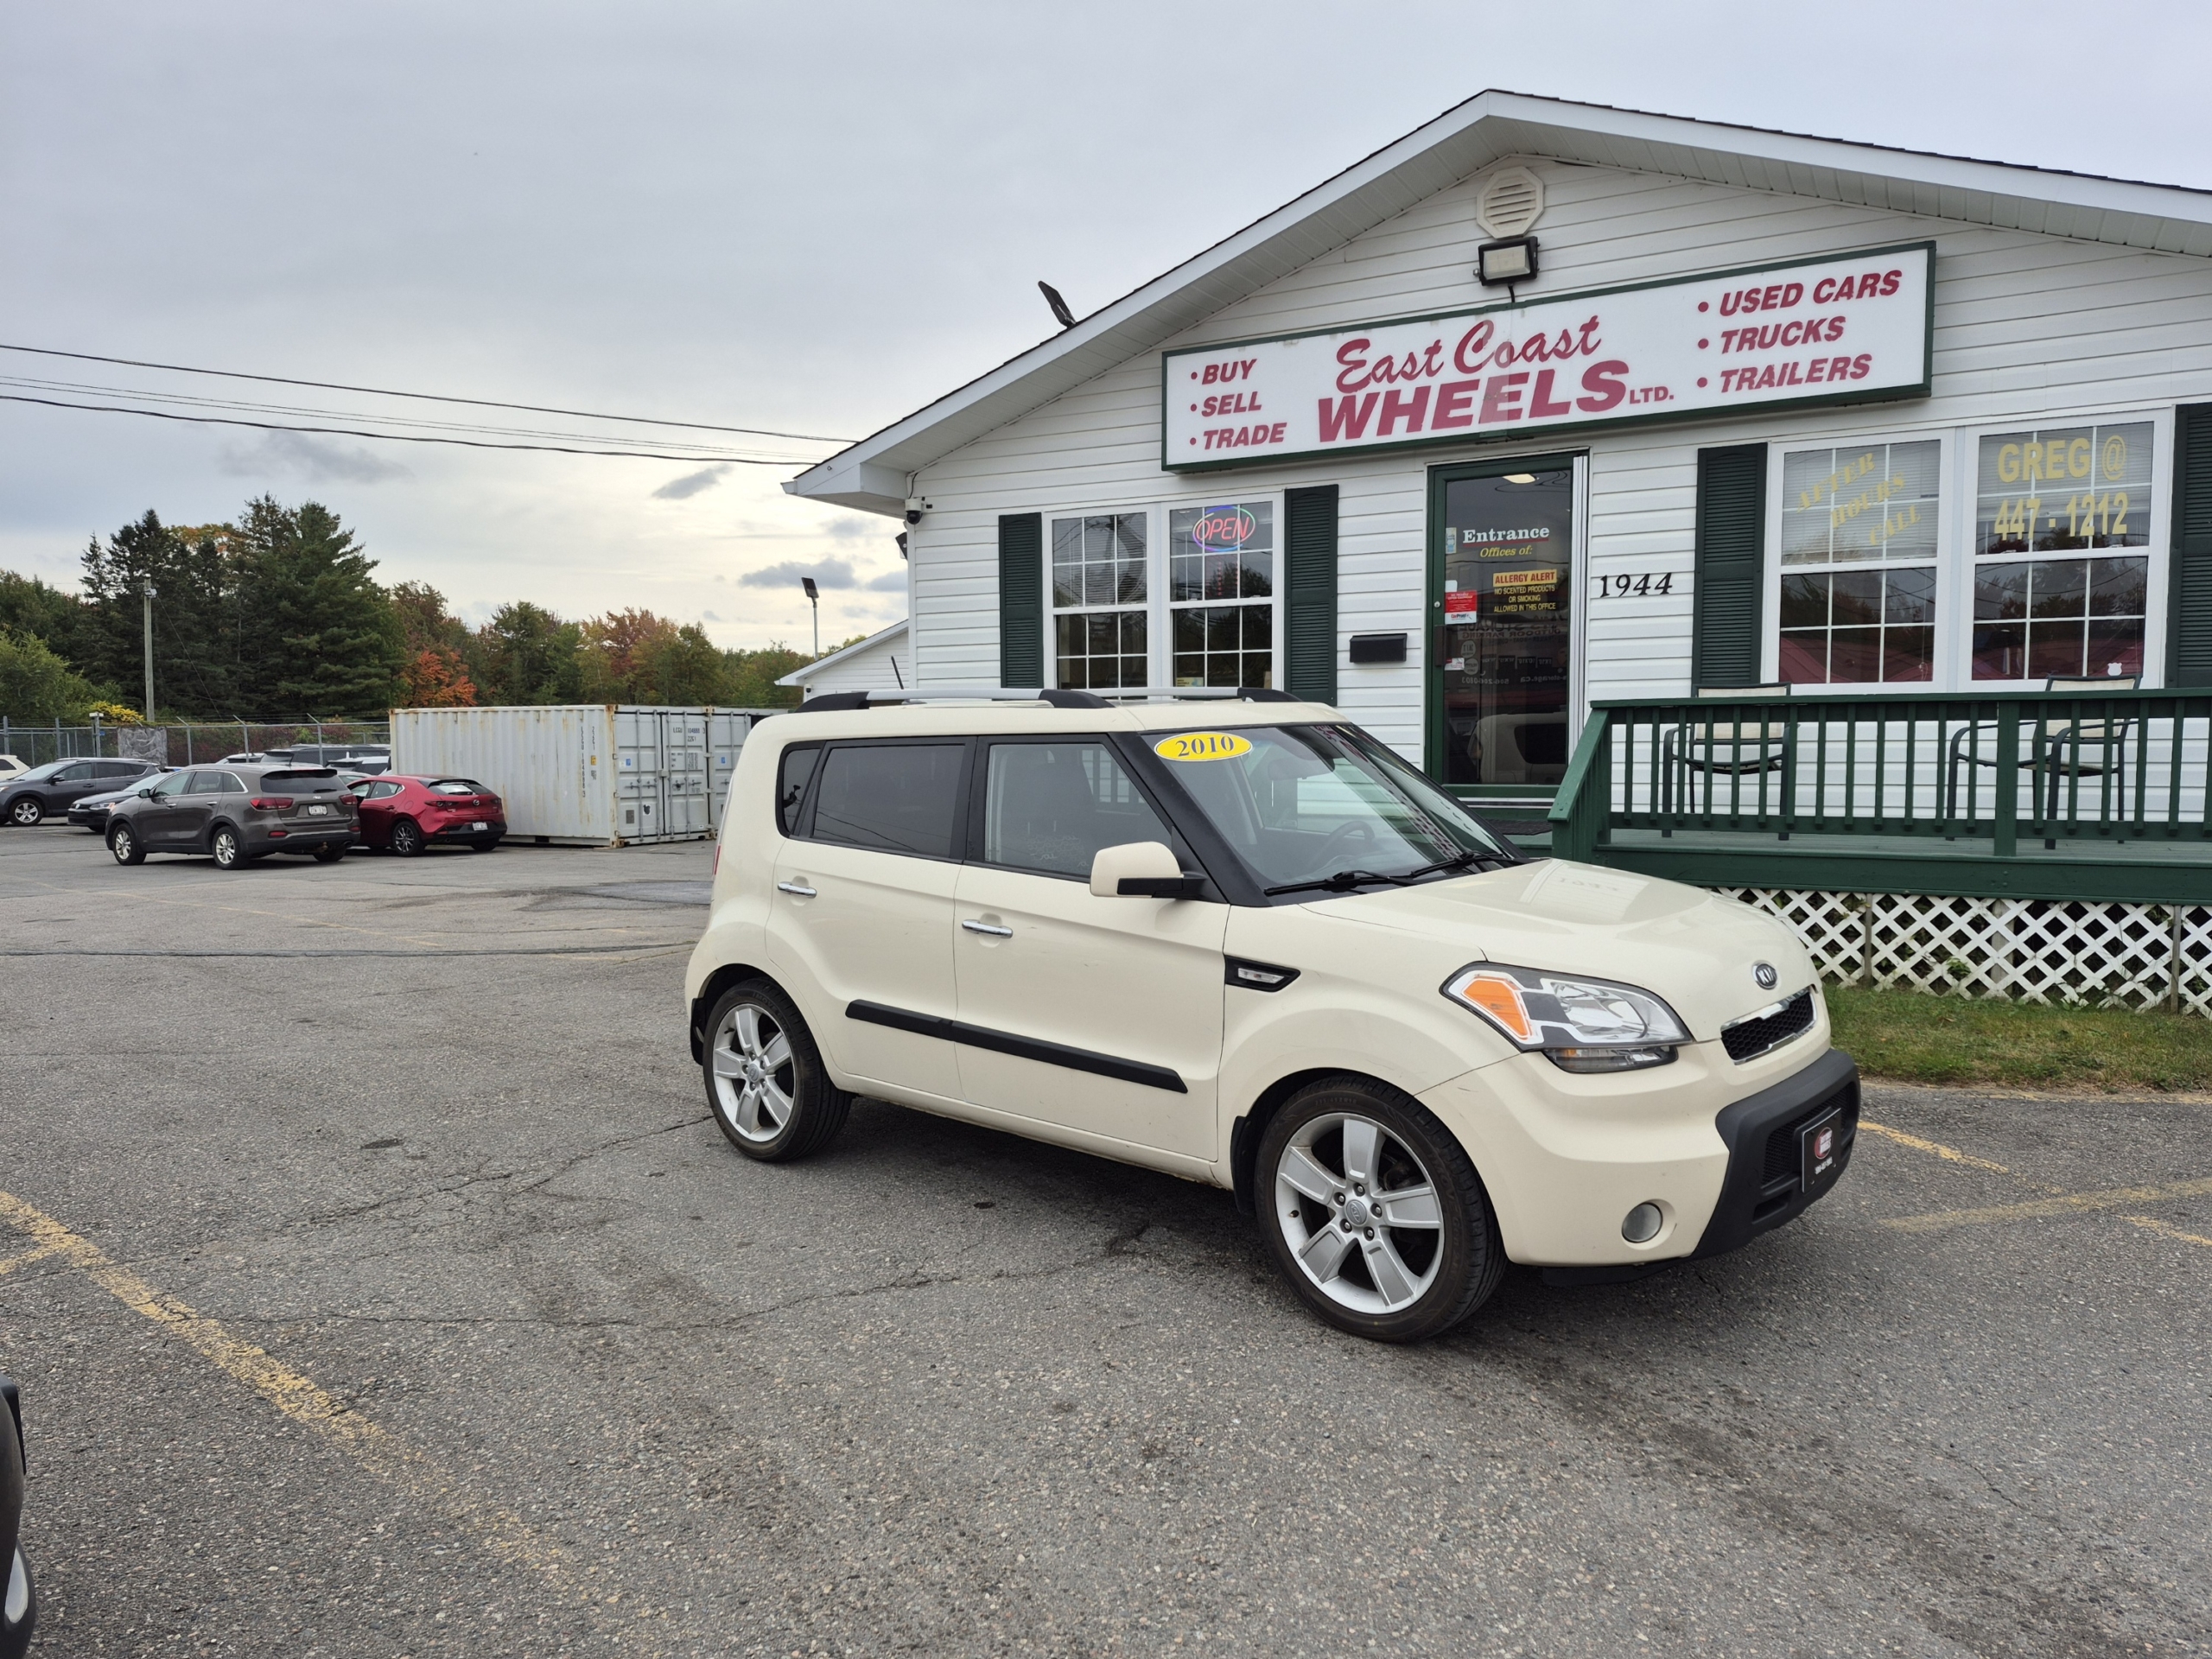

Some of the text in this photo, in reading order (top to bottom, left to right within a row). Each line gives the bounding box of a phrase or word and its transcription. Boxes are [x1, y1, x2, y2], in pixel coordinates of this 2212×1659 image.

[1719, 270, 1902, 316] USED CARS
[1720, 315, 1846, 354] TRUCKS
[1336, 315, 1602, 394] East Coast
[1201, 359, 1257, 385] BUY
[1719, 353, 1872, 393] TRAILERS
[1201, 391, 1262, 417] SELL
[1318, 359, 1675, 443] WHEELS LTD.
[1203, 422, 1287, 450] TRADE
[1998, 437, 2091, 483] GREG
[1796, 452, 1876, 514] AFTER
[1831, 472, 1905, 529] HOURS
[1196, 516, 1250, 541] OPEN
[1462, 527, 1550, 543] Entrance
[1868, 505, 1922, 546] CALL
[1479, 545, 1533, 557] Offices of:
[1495, 571, 1555, 584] ALLERGY ALERT
[1599, 572, 1673, 599] 1944
[1175, 735, 1235, 757] 2010
